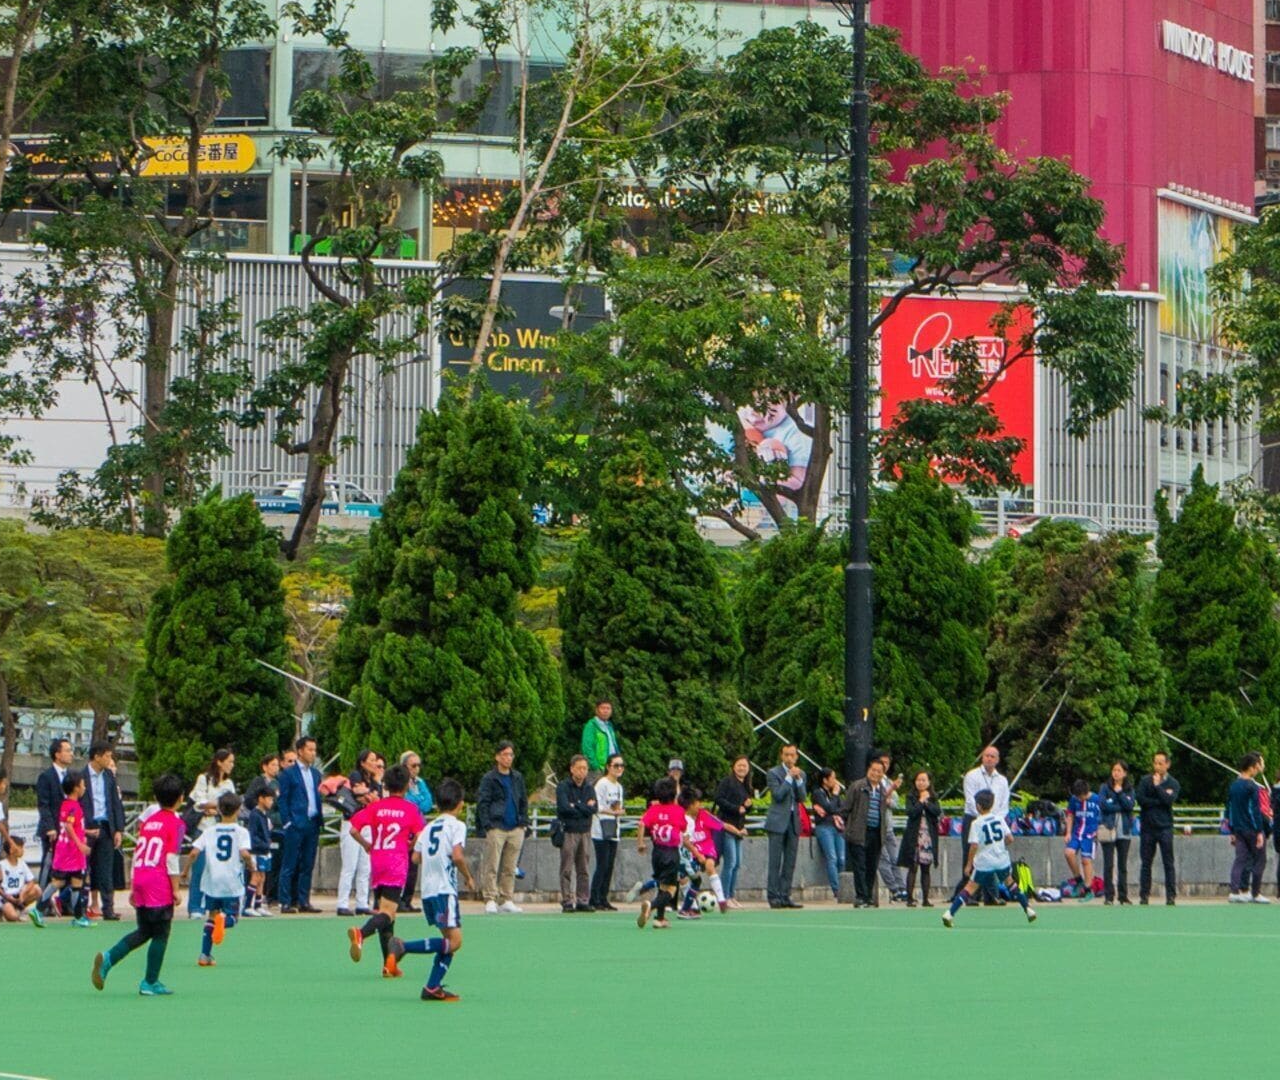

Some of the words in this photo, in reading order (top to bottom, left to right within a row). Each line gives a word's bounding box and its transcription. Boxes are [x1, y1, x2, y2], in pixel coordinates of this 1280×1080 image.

[1162, 19, 1216, 68] WINDSOR
[1217, 42, 1255, 82] HOUSE
[216, 834, 233, 862] 9
[373, 822, 401, 850] 12
[428, 824, 444, 857] 5
[982, 820, 1003, 846] 15
[135, 836, 163, 868] 20
